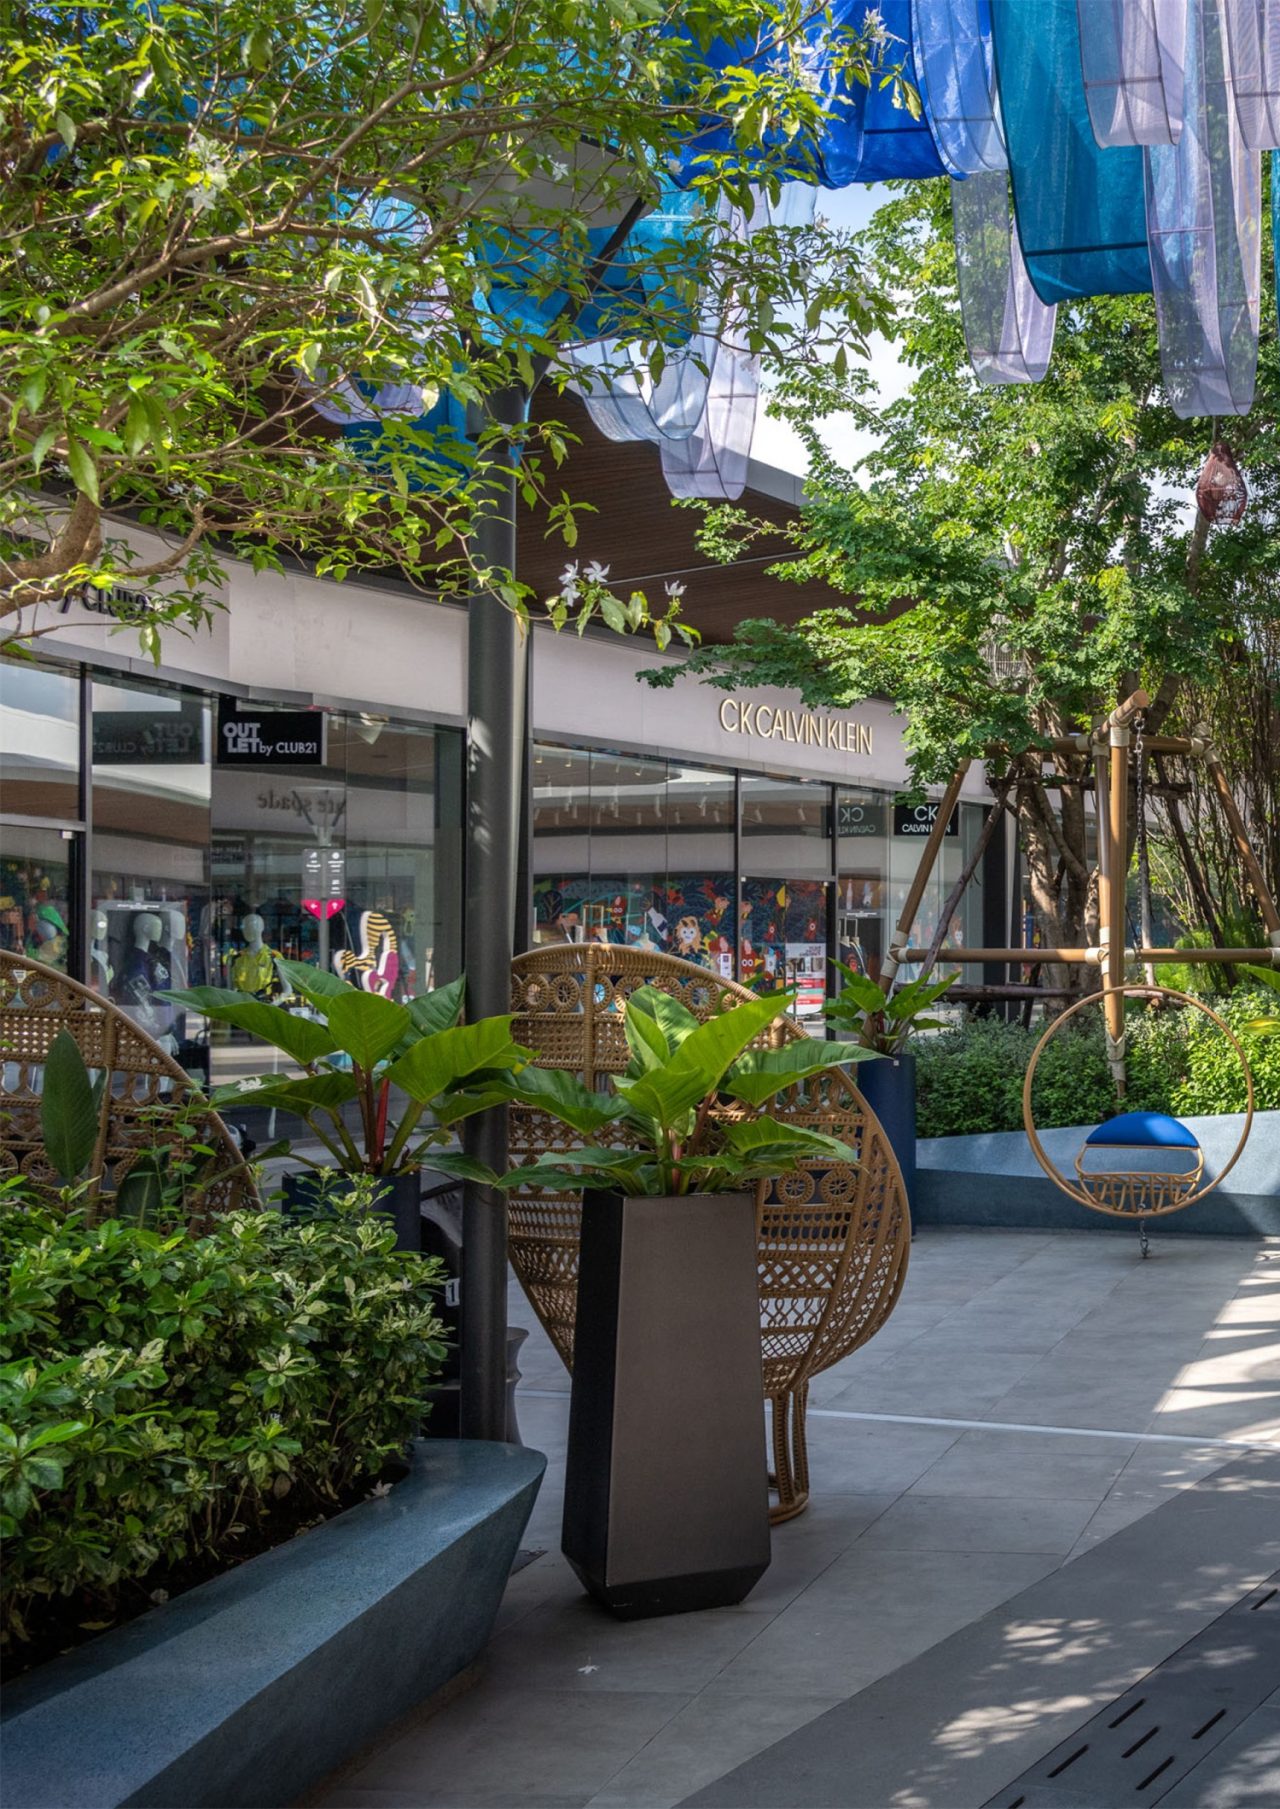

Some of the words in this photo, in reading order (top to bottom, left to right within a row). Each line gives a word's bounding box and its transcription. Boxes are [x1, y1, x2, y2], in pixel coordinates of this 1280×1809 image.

[223, 722, 261, 738] OUT
[719, 698, 754, 735] CK
[755, 705, 823, 747] CALVIN
[826, 718, 873, 755] KLEIN
[227, 738, 260, 753] LET
[260, 742, 273, 757] by
[276, 742, 317, 754] CLUB21
[914, 805, 939, 821] CK
[902, 824, 929, 833] CALVIN
